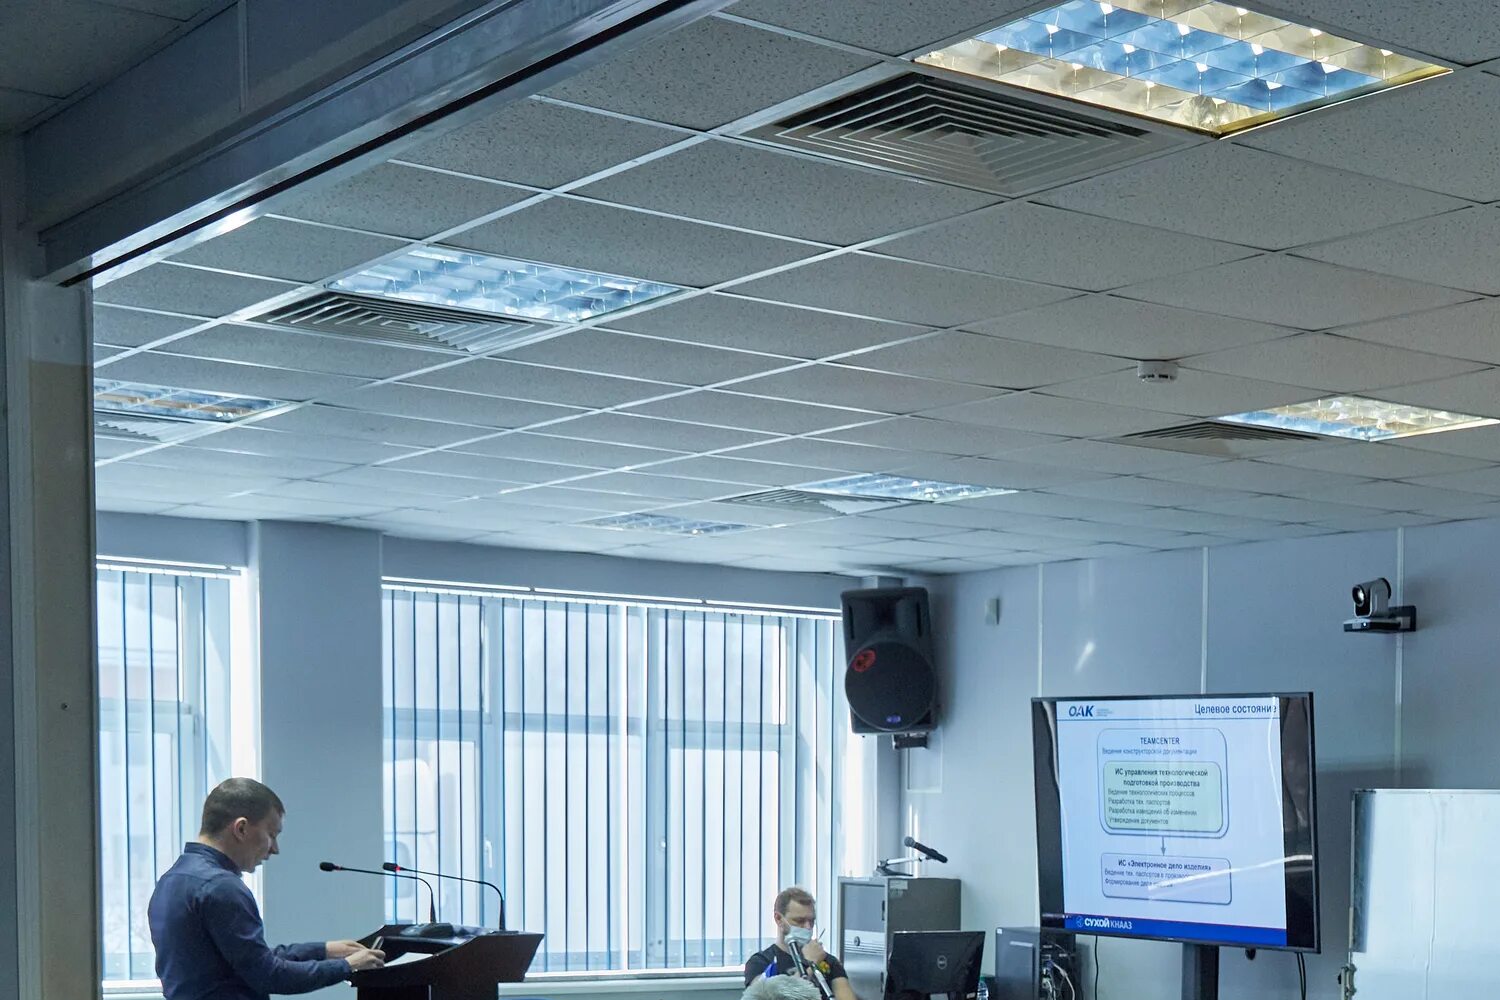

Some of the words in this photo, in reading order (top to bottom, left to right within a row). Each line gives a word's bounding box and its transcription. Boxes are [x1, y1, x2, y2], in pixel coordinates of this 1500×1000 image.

[1194, 703, 1230, 716] Целевое
[1140, 736, 1180, 745] TEAMCENTER
[1084, 916, 1110, 929] СУХОЙ
[1110, 919, 1133, 930] КНААЗ
